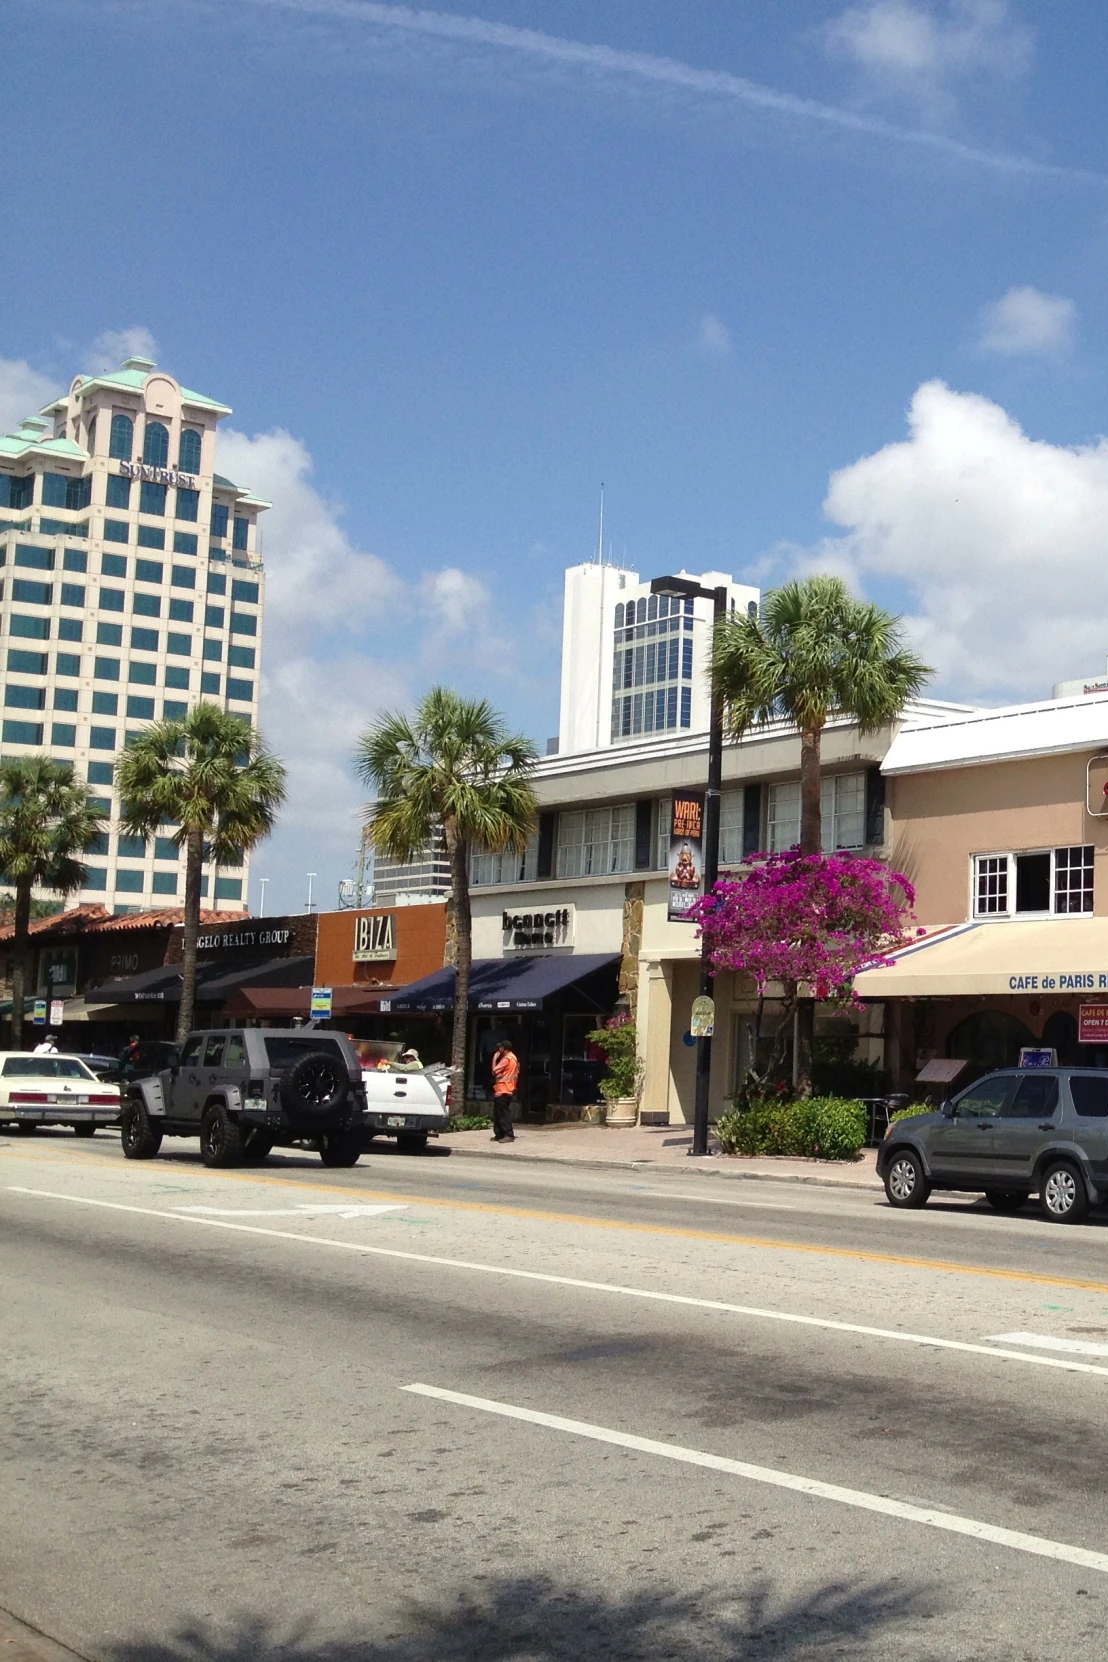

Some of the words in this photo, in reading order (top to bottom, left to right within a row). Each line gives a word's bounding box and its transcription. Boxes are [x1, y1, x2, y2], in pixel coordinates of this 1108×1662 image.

[675, 800, 701, 820] WARI:
[502, 909, 570, 930] bennett
[222, 932, 256, 947] REALTY
[259, 930, 290, 944] GROUP
[354, 915, 393, 951] IBIZA
[111, 954, 139, 971] PRIMO
[1009, 976, 1038, 990] CAFE
[1041, 975, 1056, 989] de
[1059, 974, 1094, 989] PARIS
